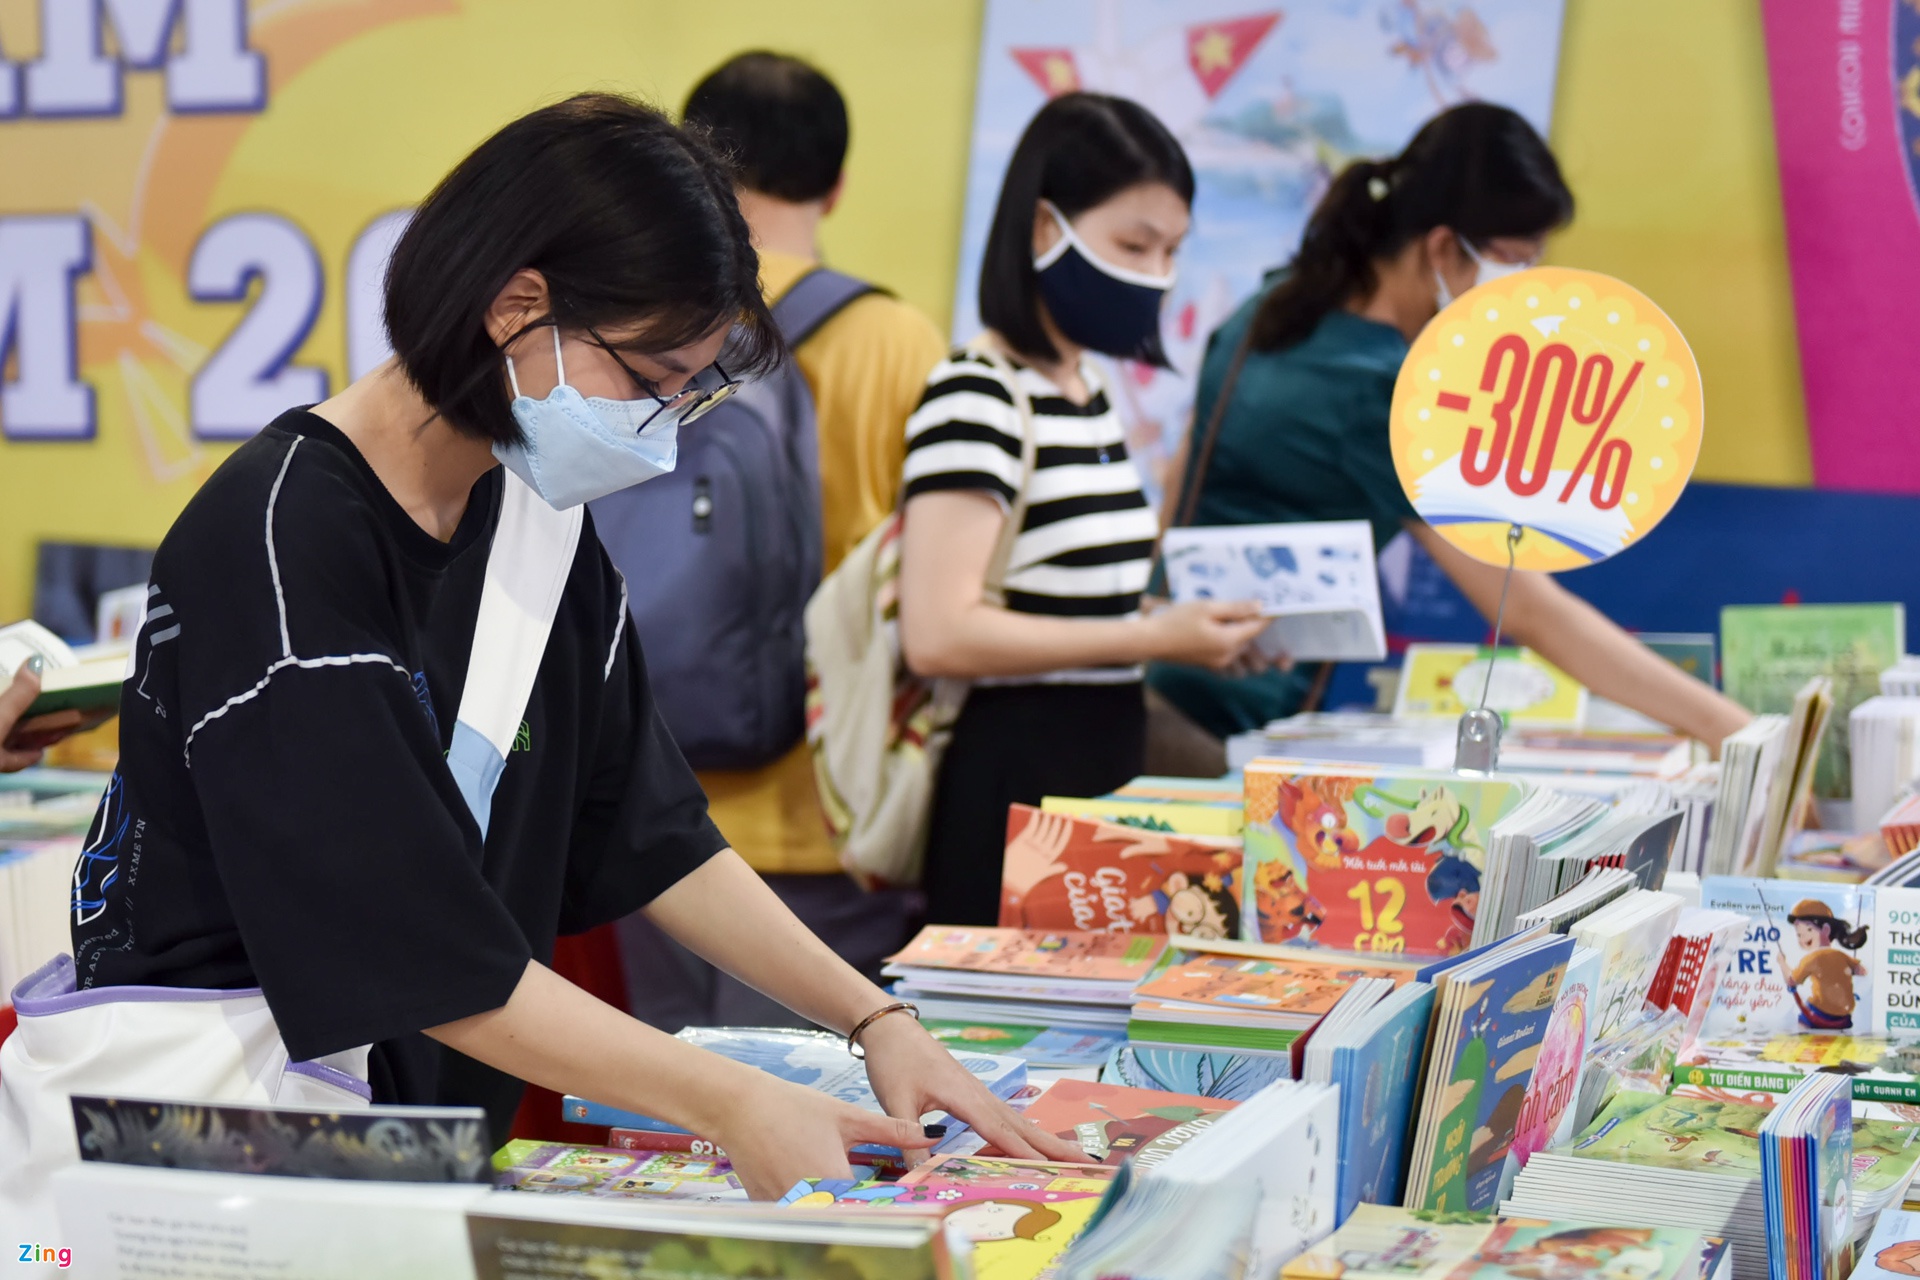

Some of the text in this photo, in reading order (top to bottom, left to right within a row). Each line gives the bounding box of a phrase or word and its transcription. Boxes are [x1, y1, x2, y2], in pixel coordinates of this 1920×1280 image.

[1437, 333, 1645, 511] -30%
[1347, 877, 1406, 935] 12
[1873, 1087, 1903, 1097] QUANH
[1905, 1088, 1917, 1098] EM
